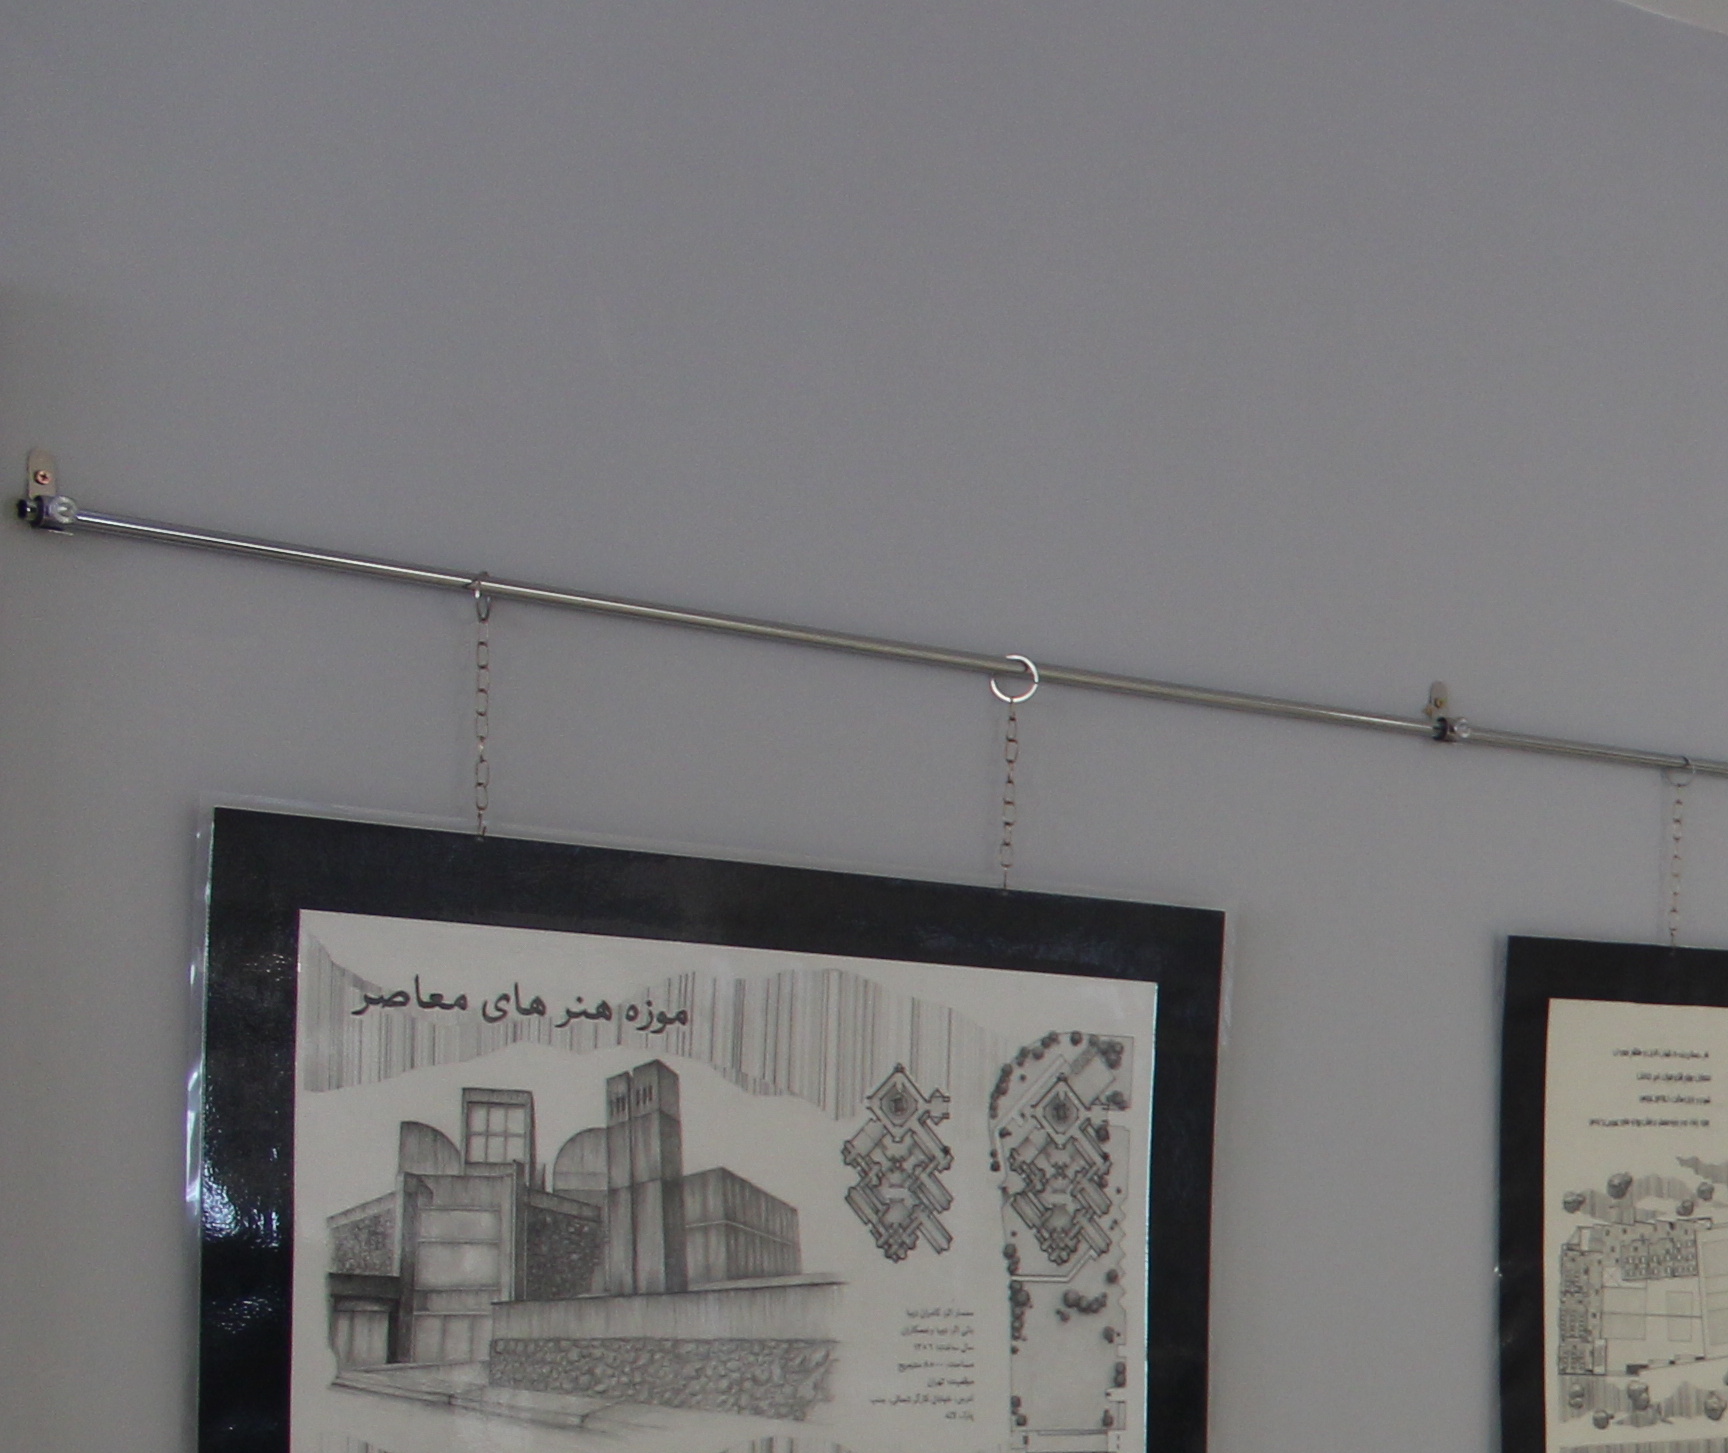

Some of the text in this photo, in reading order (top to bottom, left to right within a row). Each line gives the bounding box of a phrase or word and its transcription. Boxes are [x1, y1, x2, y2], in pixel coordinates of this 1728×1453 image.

[351, 974, 689, 1034] موزه هنر های معاصر
